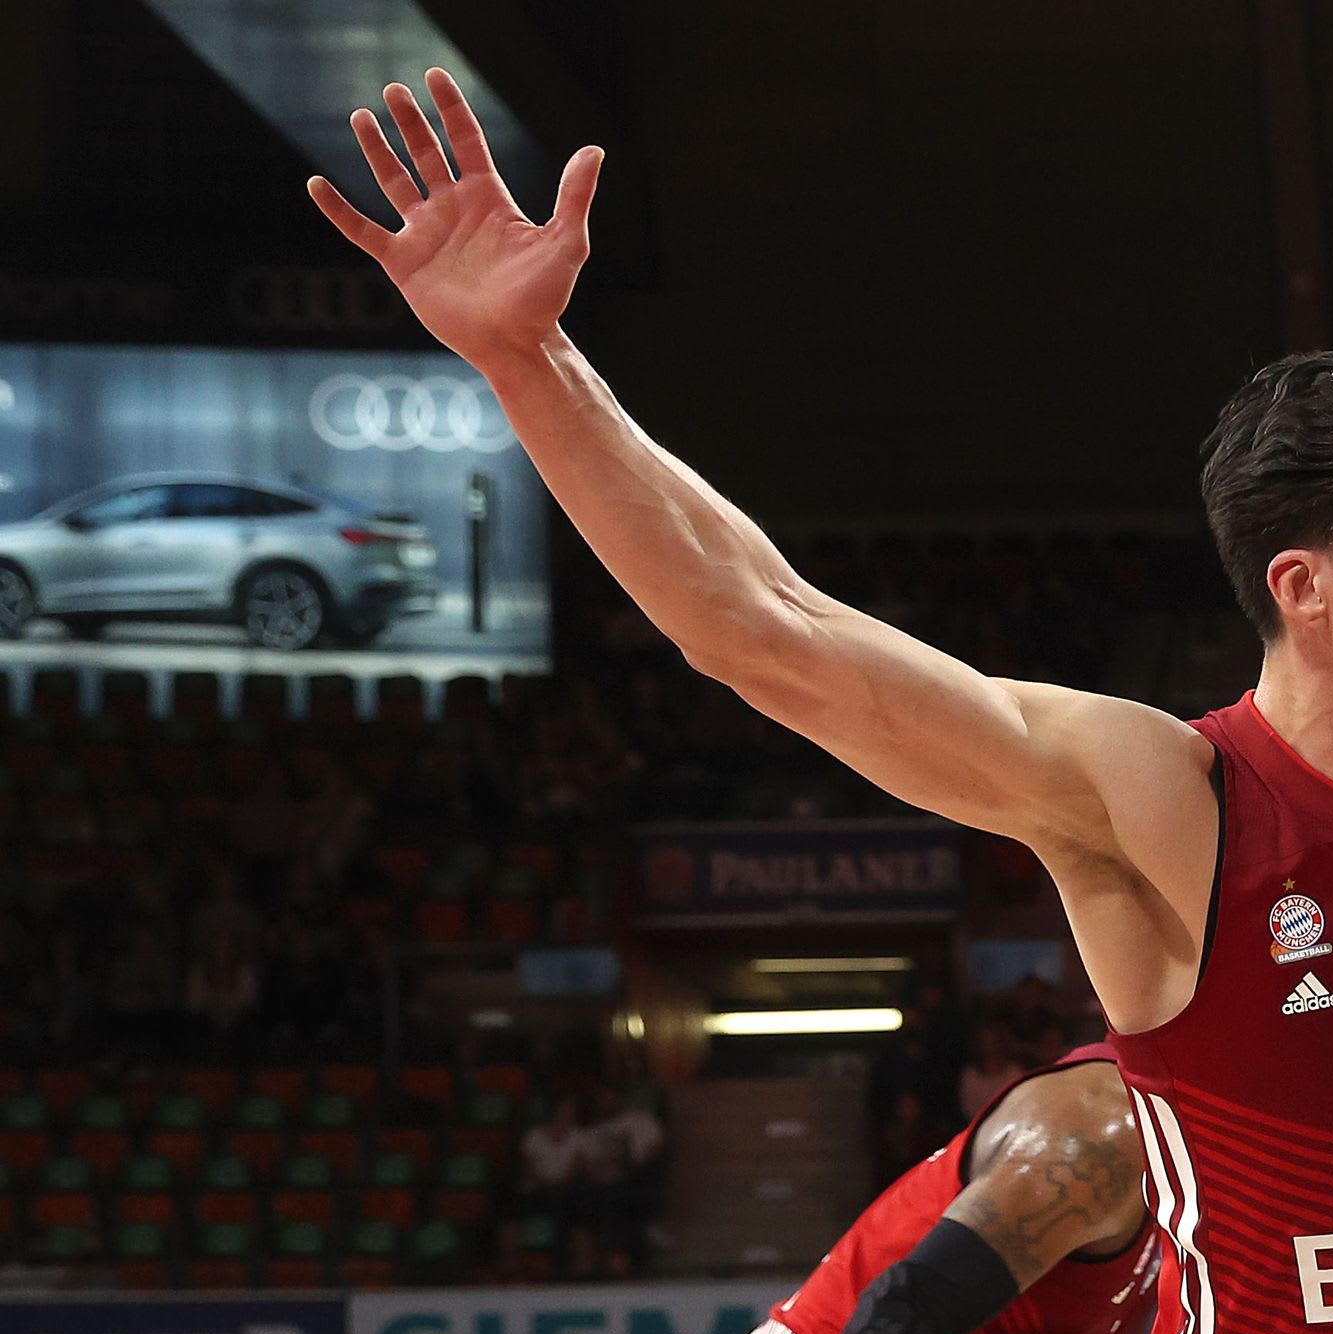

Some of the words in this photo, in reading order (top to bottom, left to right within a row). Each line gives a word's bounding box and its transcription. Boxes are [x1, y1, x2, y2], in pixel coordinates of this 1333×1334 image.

[1273, 909, 1282, 922] FC
[1280, 898, 1317, 915] BAYERN
[1278, 945, 1330, 962] BASKETBALL
